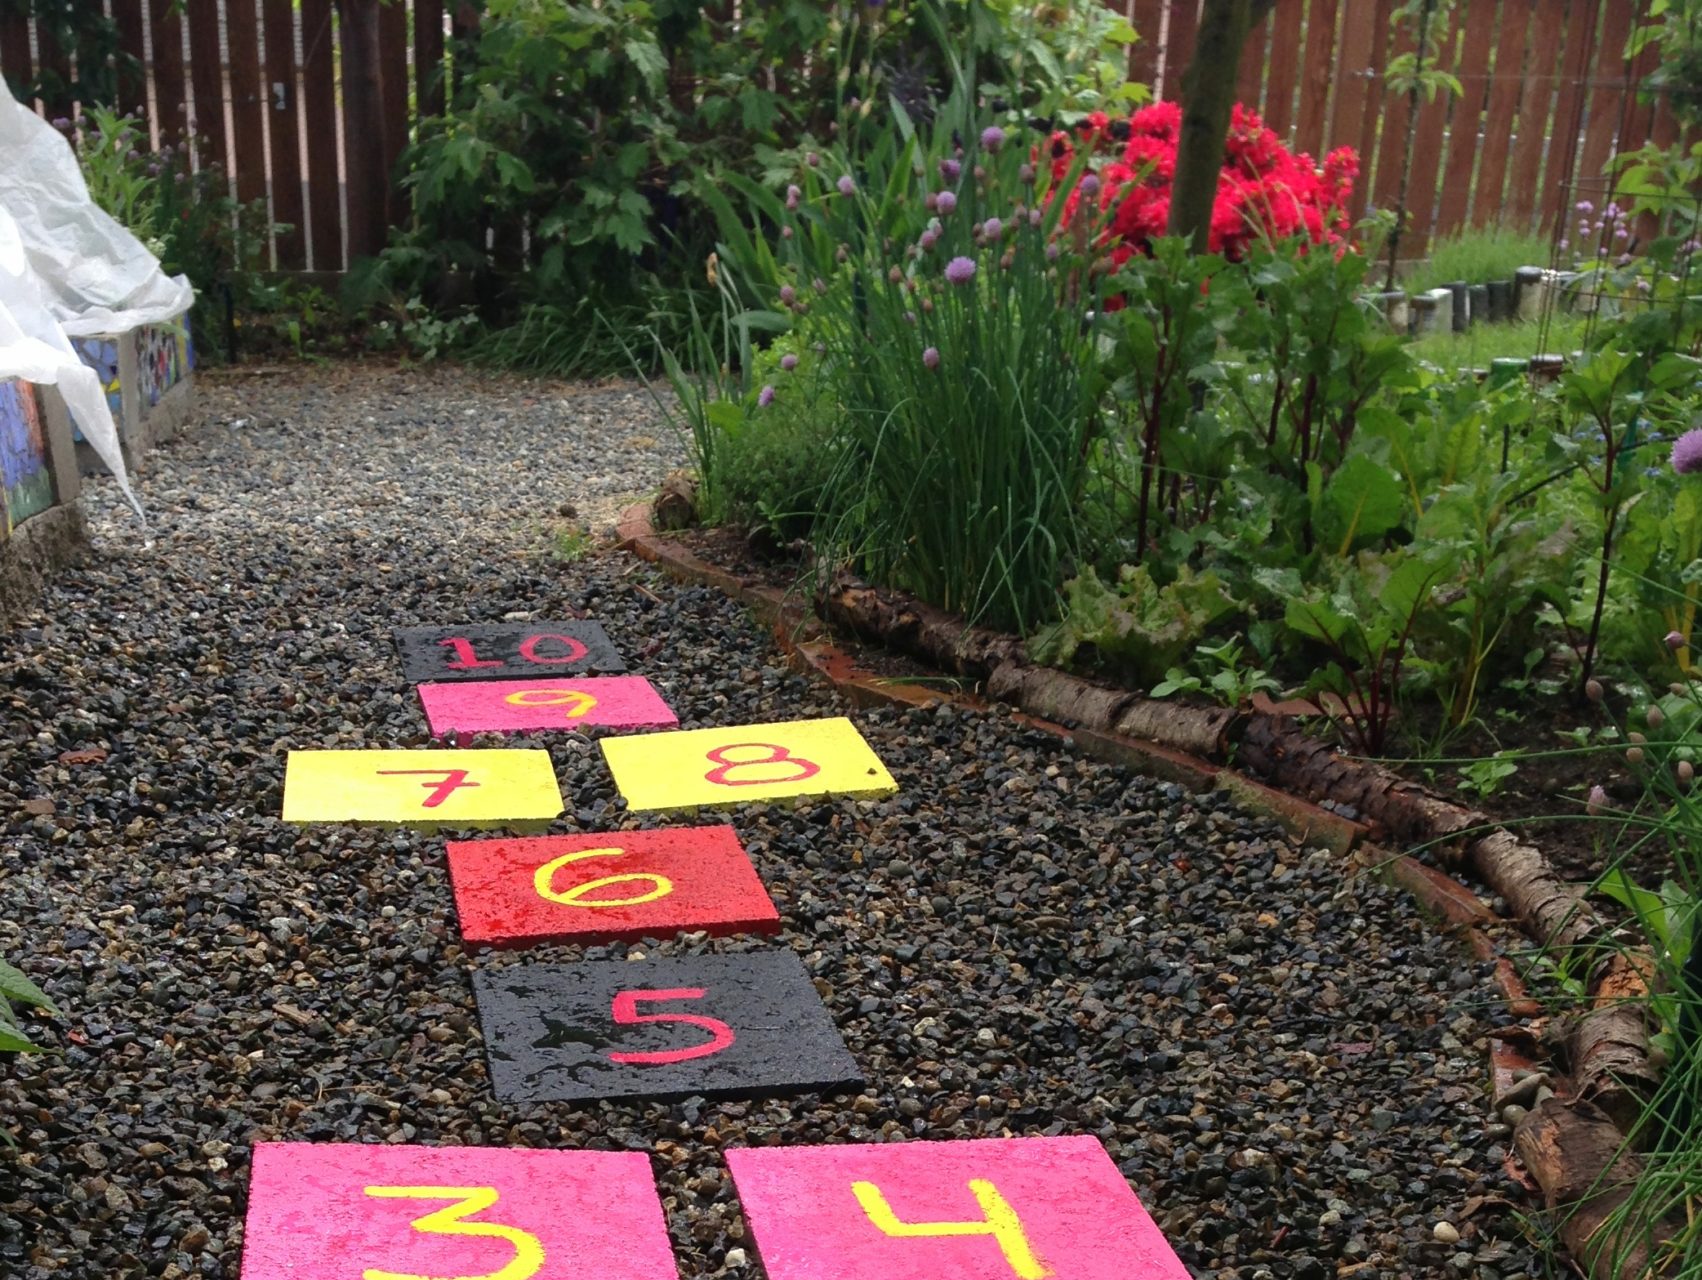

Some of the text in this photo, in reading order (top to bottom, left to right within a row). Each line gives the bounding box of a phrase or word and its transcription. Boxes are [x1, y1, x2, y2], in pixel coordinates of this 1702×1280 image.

[438, 634, 589, 669] 10
[505, 689, 598, 717] 9
[704, 743, 820, 786] 8
[376, 769, 481, 807] 7
[534, 847, 674, 907] 6
[608, 988, 736, 1063] 5
